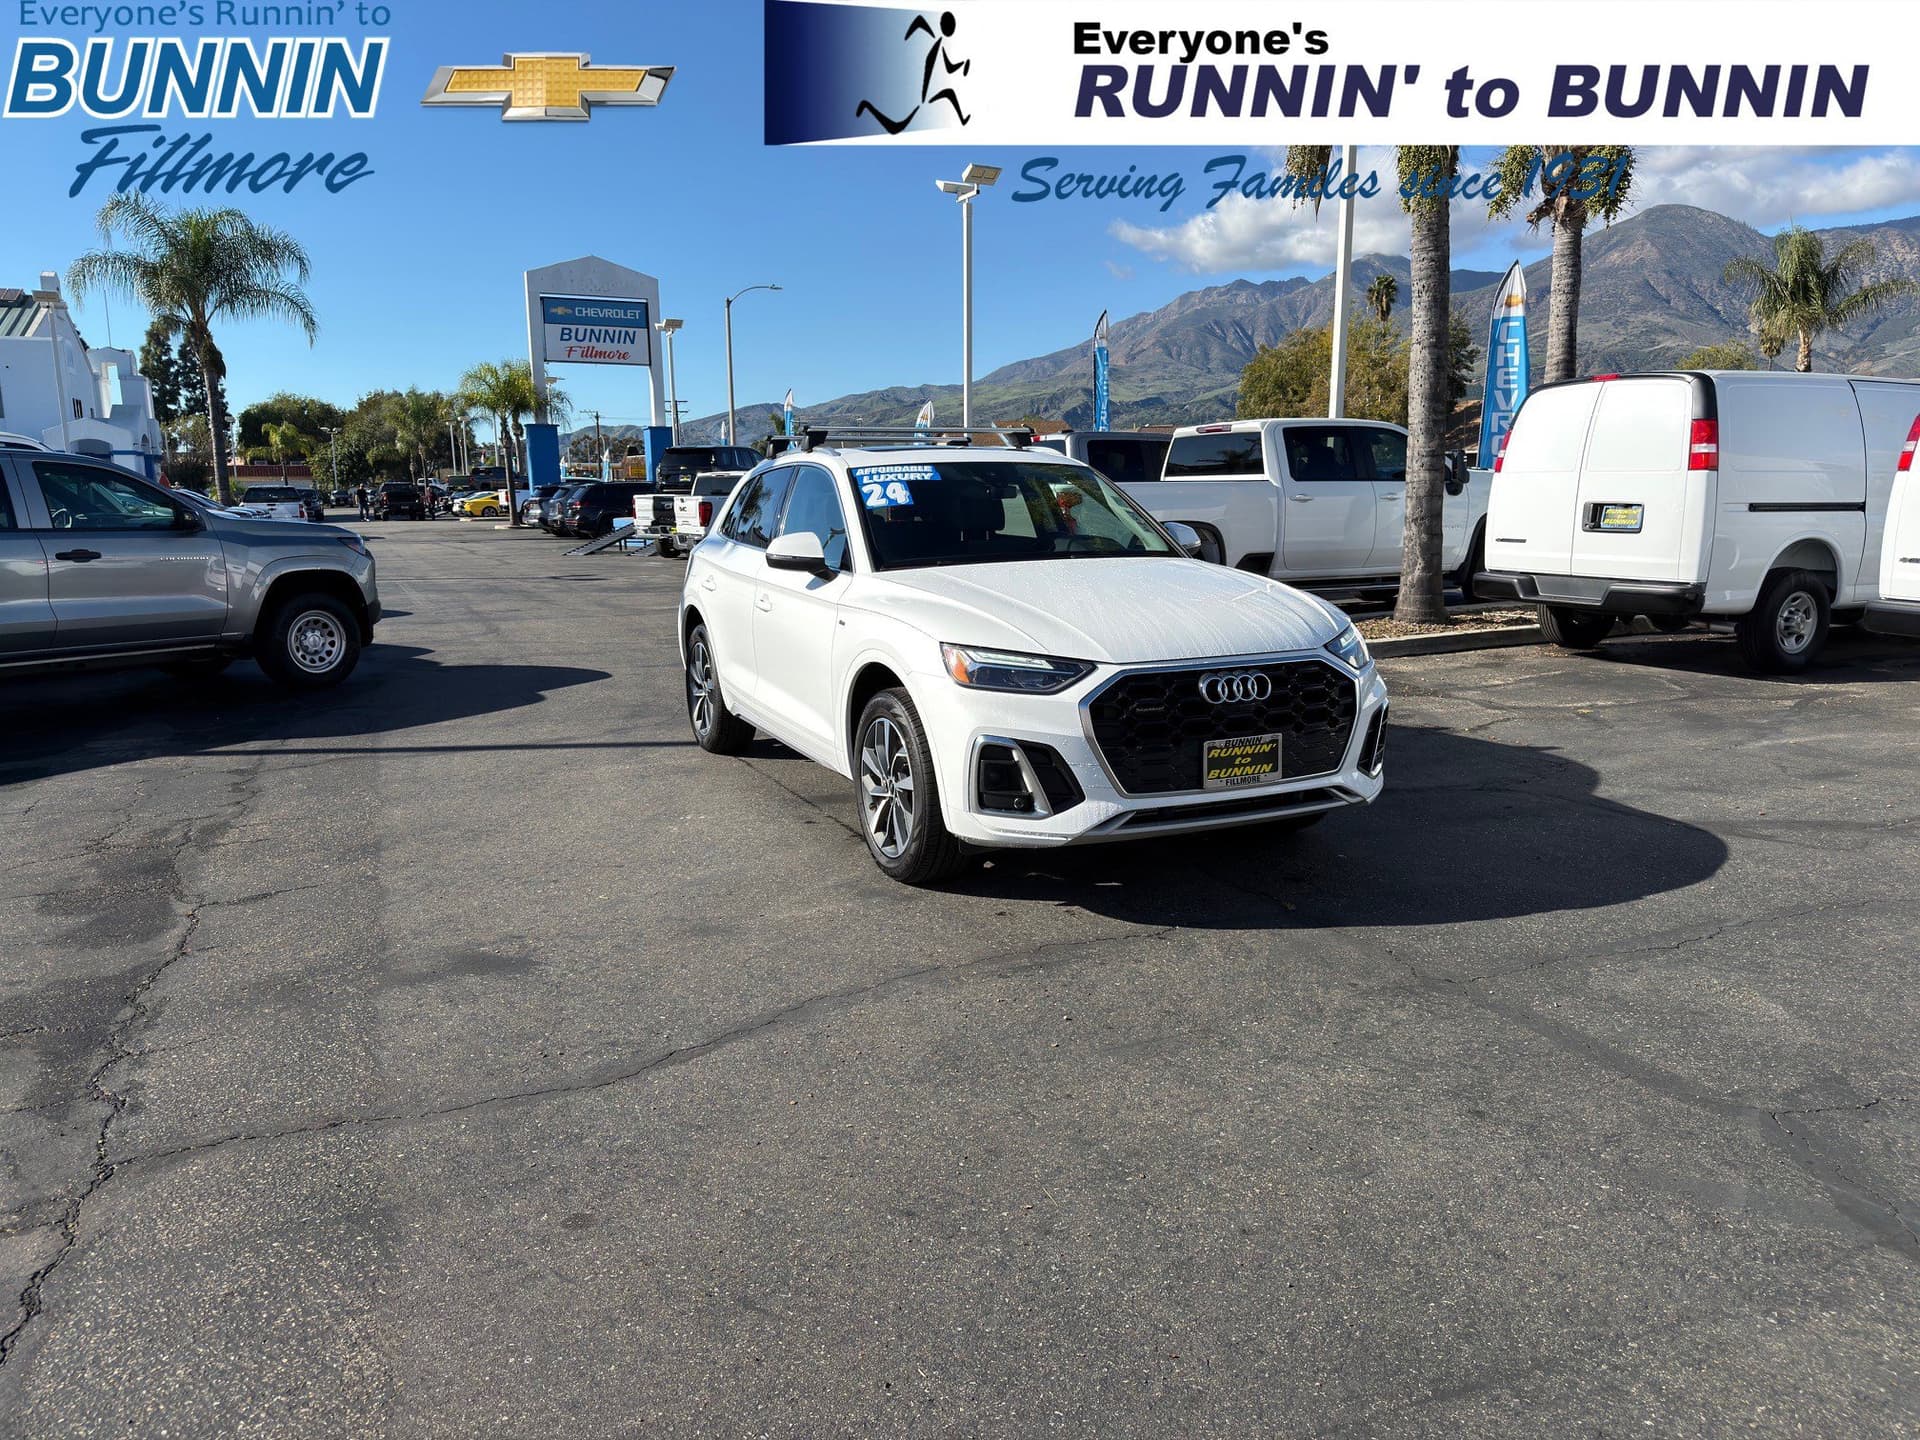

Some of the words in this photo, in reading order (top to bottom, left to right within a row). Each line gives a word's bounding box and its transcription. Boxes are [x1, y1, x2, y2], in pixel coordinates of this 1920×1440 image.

[575, 306, 640, 319] CHEVROLET
[560, 327, 636, 344] BUNNIN
[565, 345, 631, 360] Fillmore
[856, 466, 932, 475] AFFORDABLE
[863, 473, 933, 483] LUXURY
[862, 482, 910, 506] 24
[1225, 736, 1263, 747] BUNNIN
[1208, 743, 1277, 758] RUNNIN'
[1234, 757, 1252, 765] to
[1208, 763, 1273, 779] BUNNIN
[1226, 776, 1261, 786] FILLMORE
